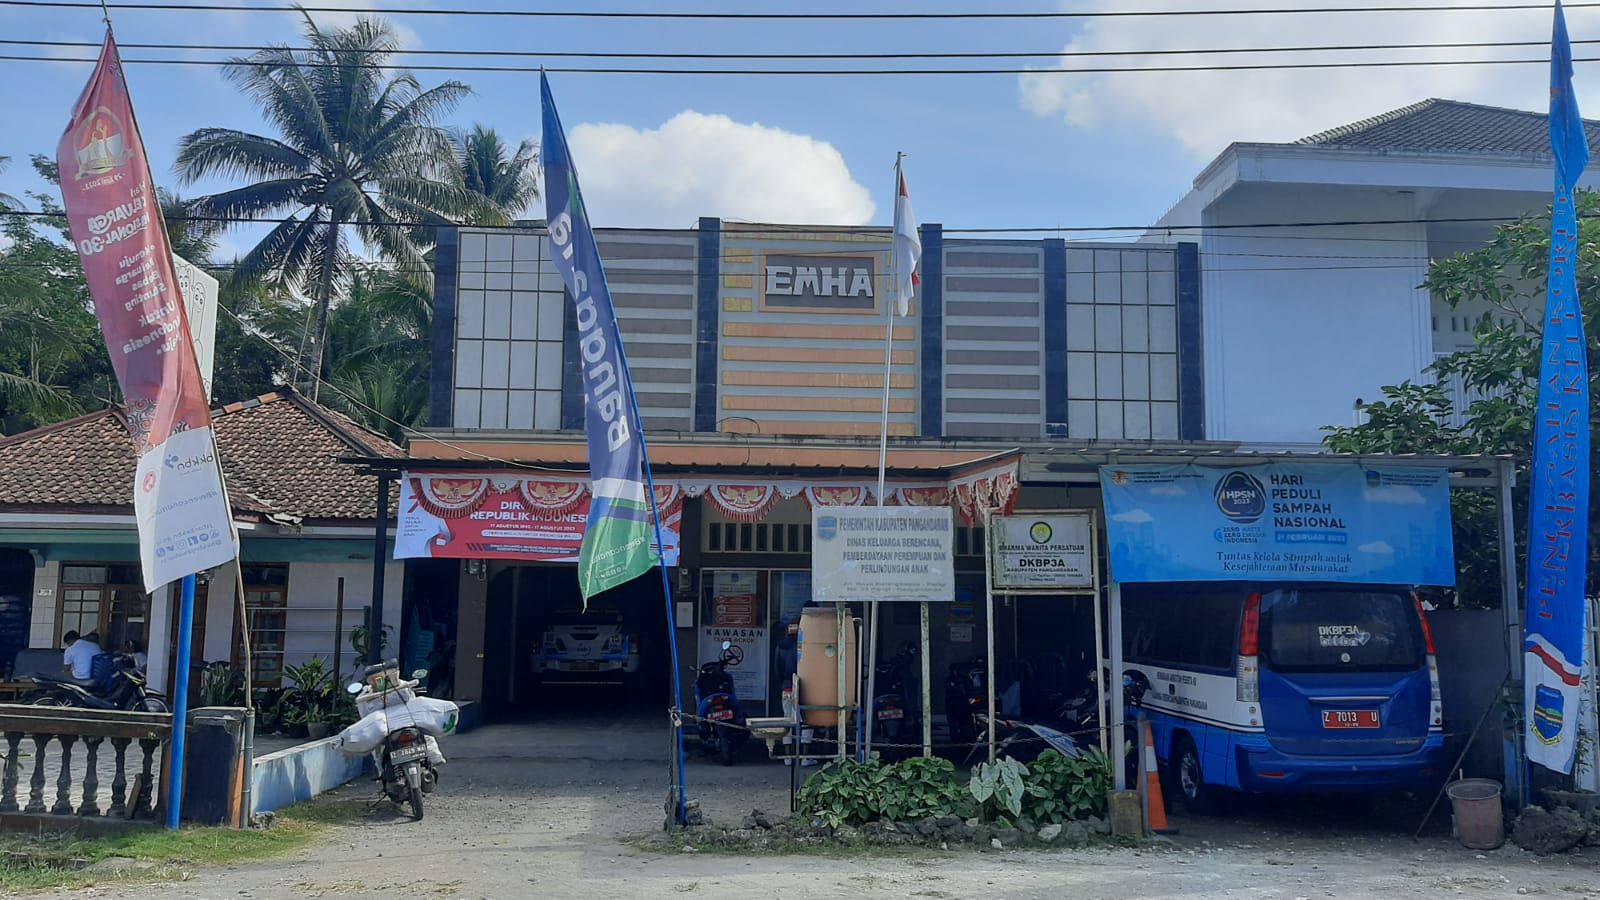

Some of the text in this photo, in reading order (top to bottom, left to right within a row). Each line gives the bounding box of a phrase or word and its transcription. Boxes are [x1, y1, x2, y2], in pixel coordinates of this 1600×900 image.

[765, 266, 872, 297] EMHA
[1270, 474, 1303, 486] HARI
[1226, 490, 1256, 499] HPSN
[1272, 489, 1320, 500] PEDULI
[1273, 503, 1331, 514] SAMPAH
[470, 511, 529, 520] REPUBLIK
[840, 517, 949, 531] PEMERINTAH KABUPATEN PANGANDARAN
[1274, 517, 1346, 528] NASIONAL
[847, 538, 866, 547] DINAS
[867, 539, 900, 547] KELUARGA
[843, 552, 946, 561] PEMBERDAYAAN PEREMPUAN DAN
[1216, 552, 1250, 561] Tuntas
[1284, 552, 1322, 563] Sampah
[1325, 553, 1352, 563] untuk
[1020, 559, 1065, 567] DKBP3A
[1224, 562, 1348, 574] Kesejahteraan Masyarakat
[861, 565, 928, 573] PERLINDUNGAN ANAK
[707, 629, 763, 637] KAWASAN
[1318, 625, 1359, 635] DKBP3A
[1324, 712, 1377, 722] Z 7013 U
